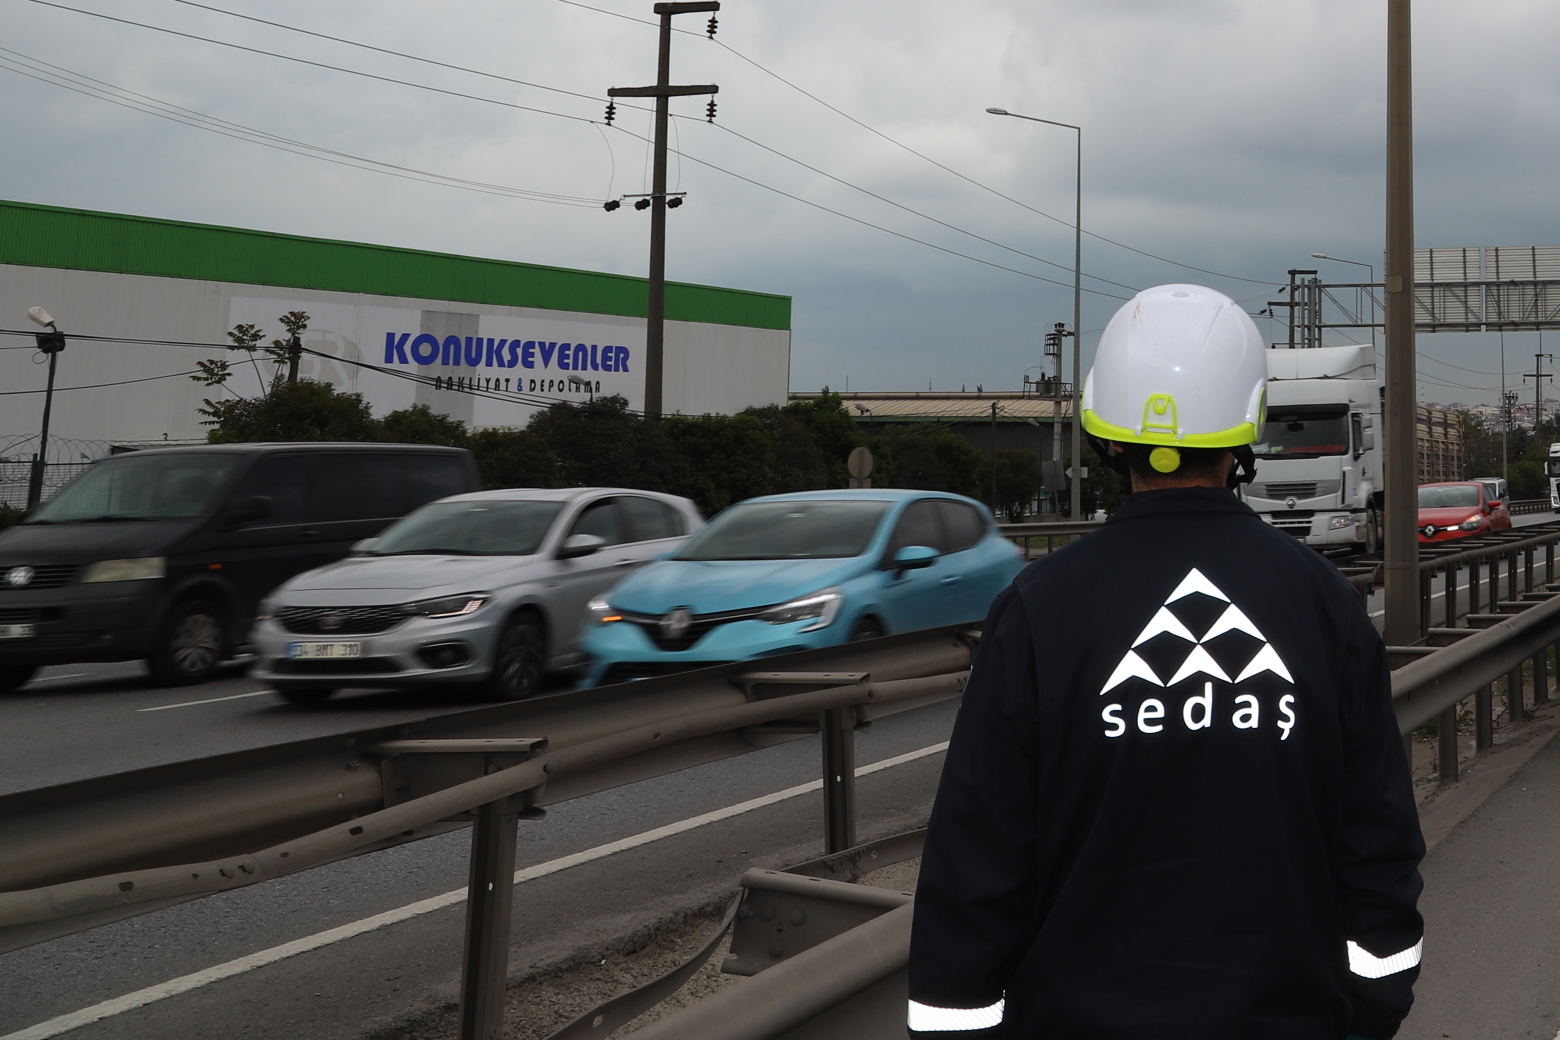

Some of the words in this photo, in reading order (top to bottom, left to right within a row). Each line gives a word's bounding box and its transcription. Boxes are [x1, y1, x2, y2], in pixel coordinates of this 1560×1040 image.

[384, 332, 630, 372] KONUKSEVENLER
[516, 378, 523, 392] &
[1101, 681, 1296, 741] sedaş
